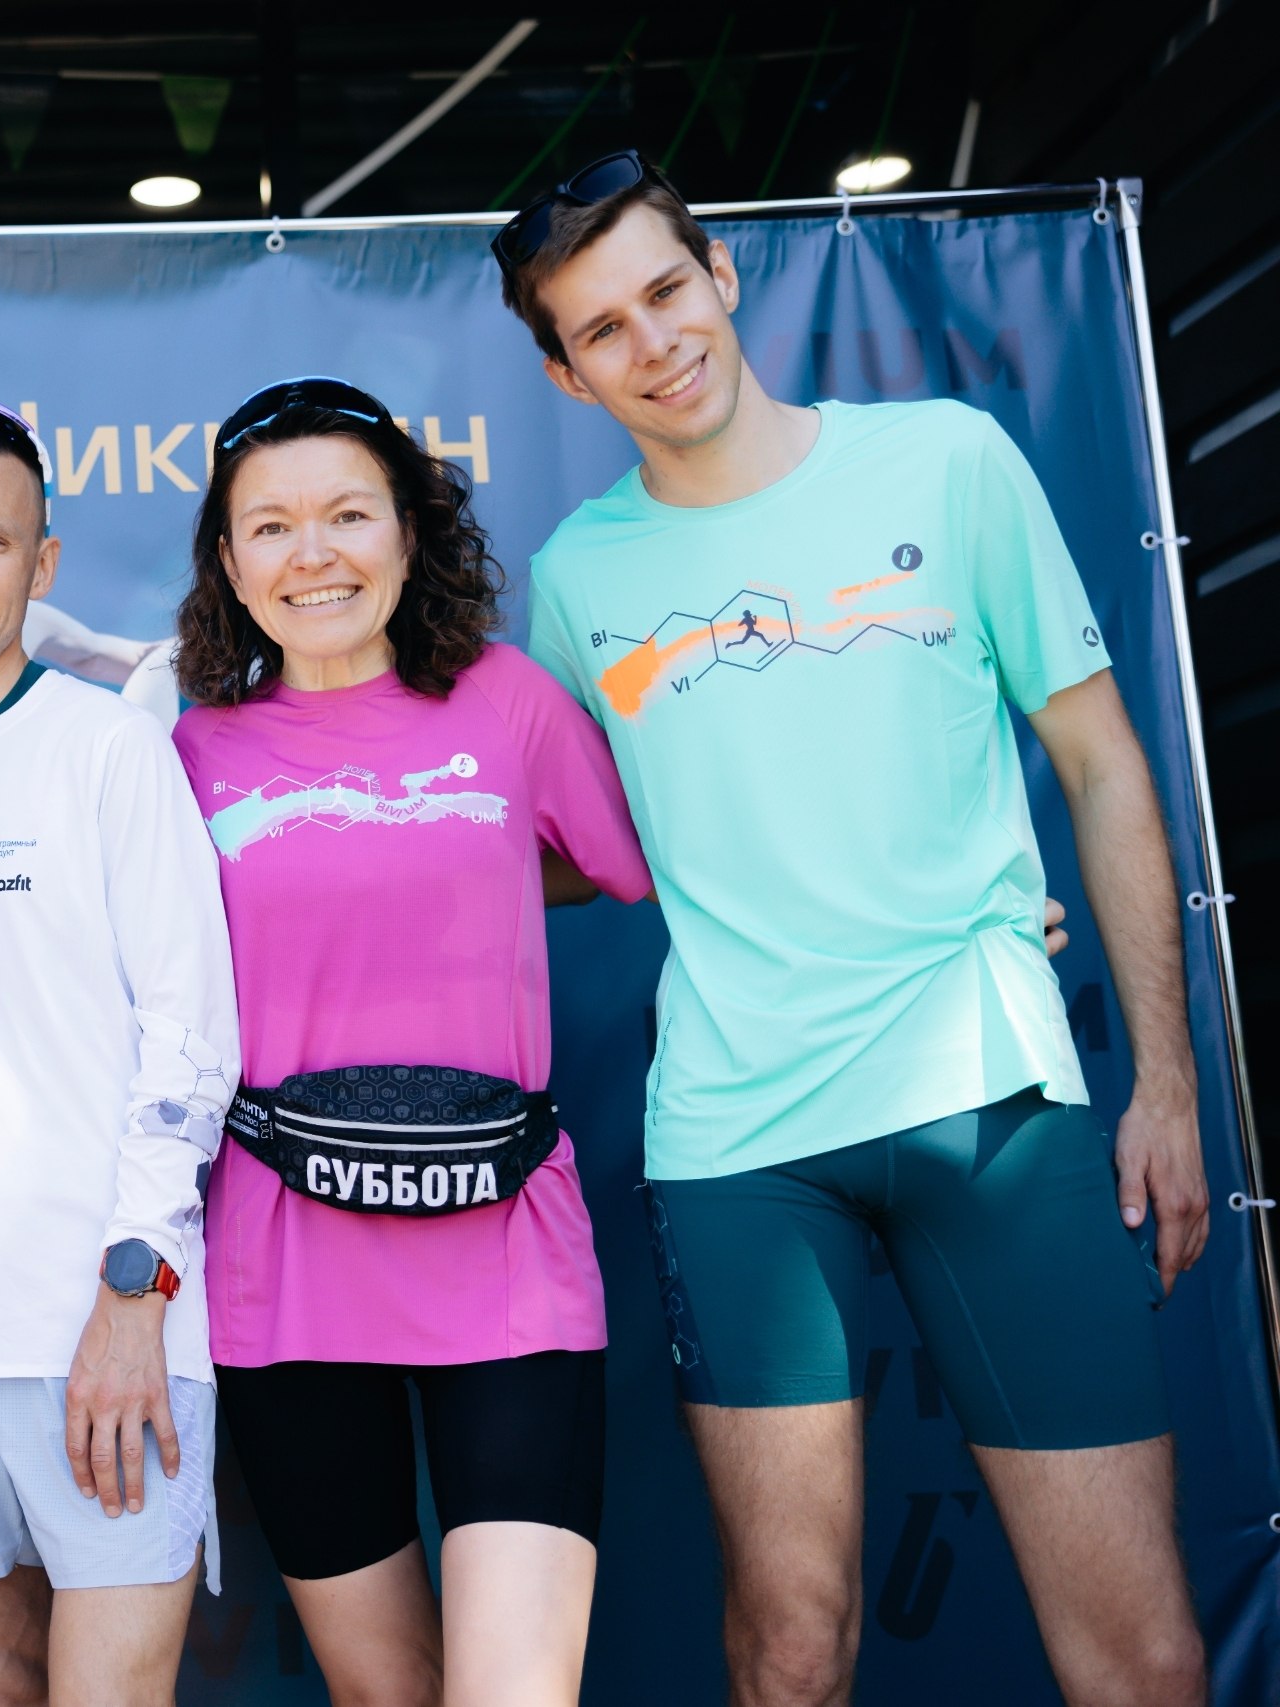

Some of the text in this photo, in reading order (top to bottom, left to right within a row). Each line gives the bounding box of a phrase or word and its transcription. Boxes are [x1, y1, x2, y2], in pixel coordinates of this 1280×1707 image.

[591, 630, 608, 648] BI
[670, 676, 690, 694] VI
[213, 780, 226, 795] BI
[268, 825, 284, 839] VI
[235, 1094, 268, 1121] РАНТЫ
[306, 1154, 498, 1207] СУББОТА
